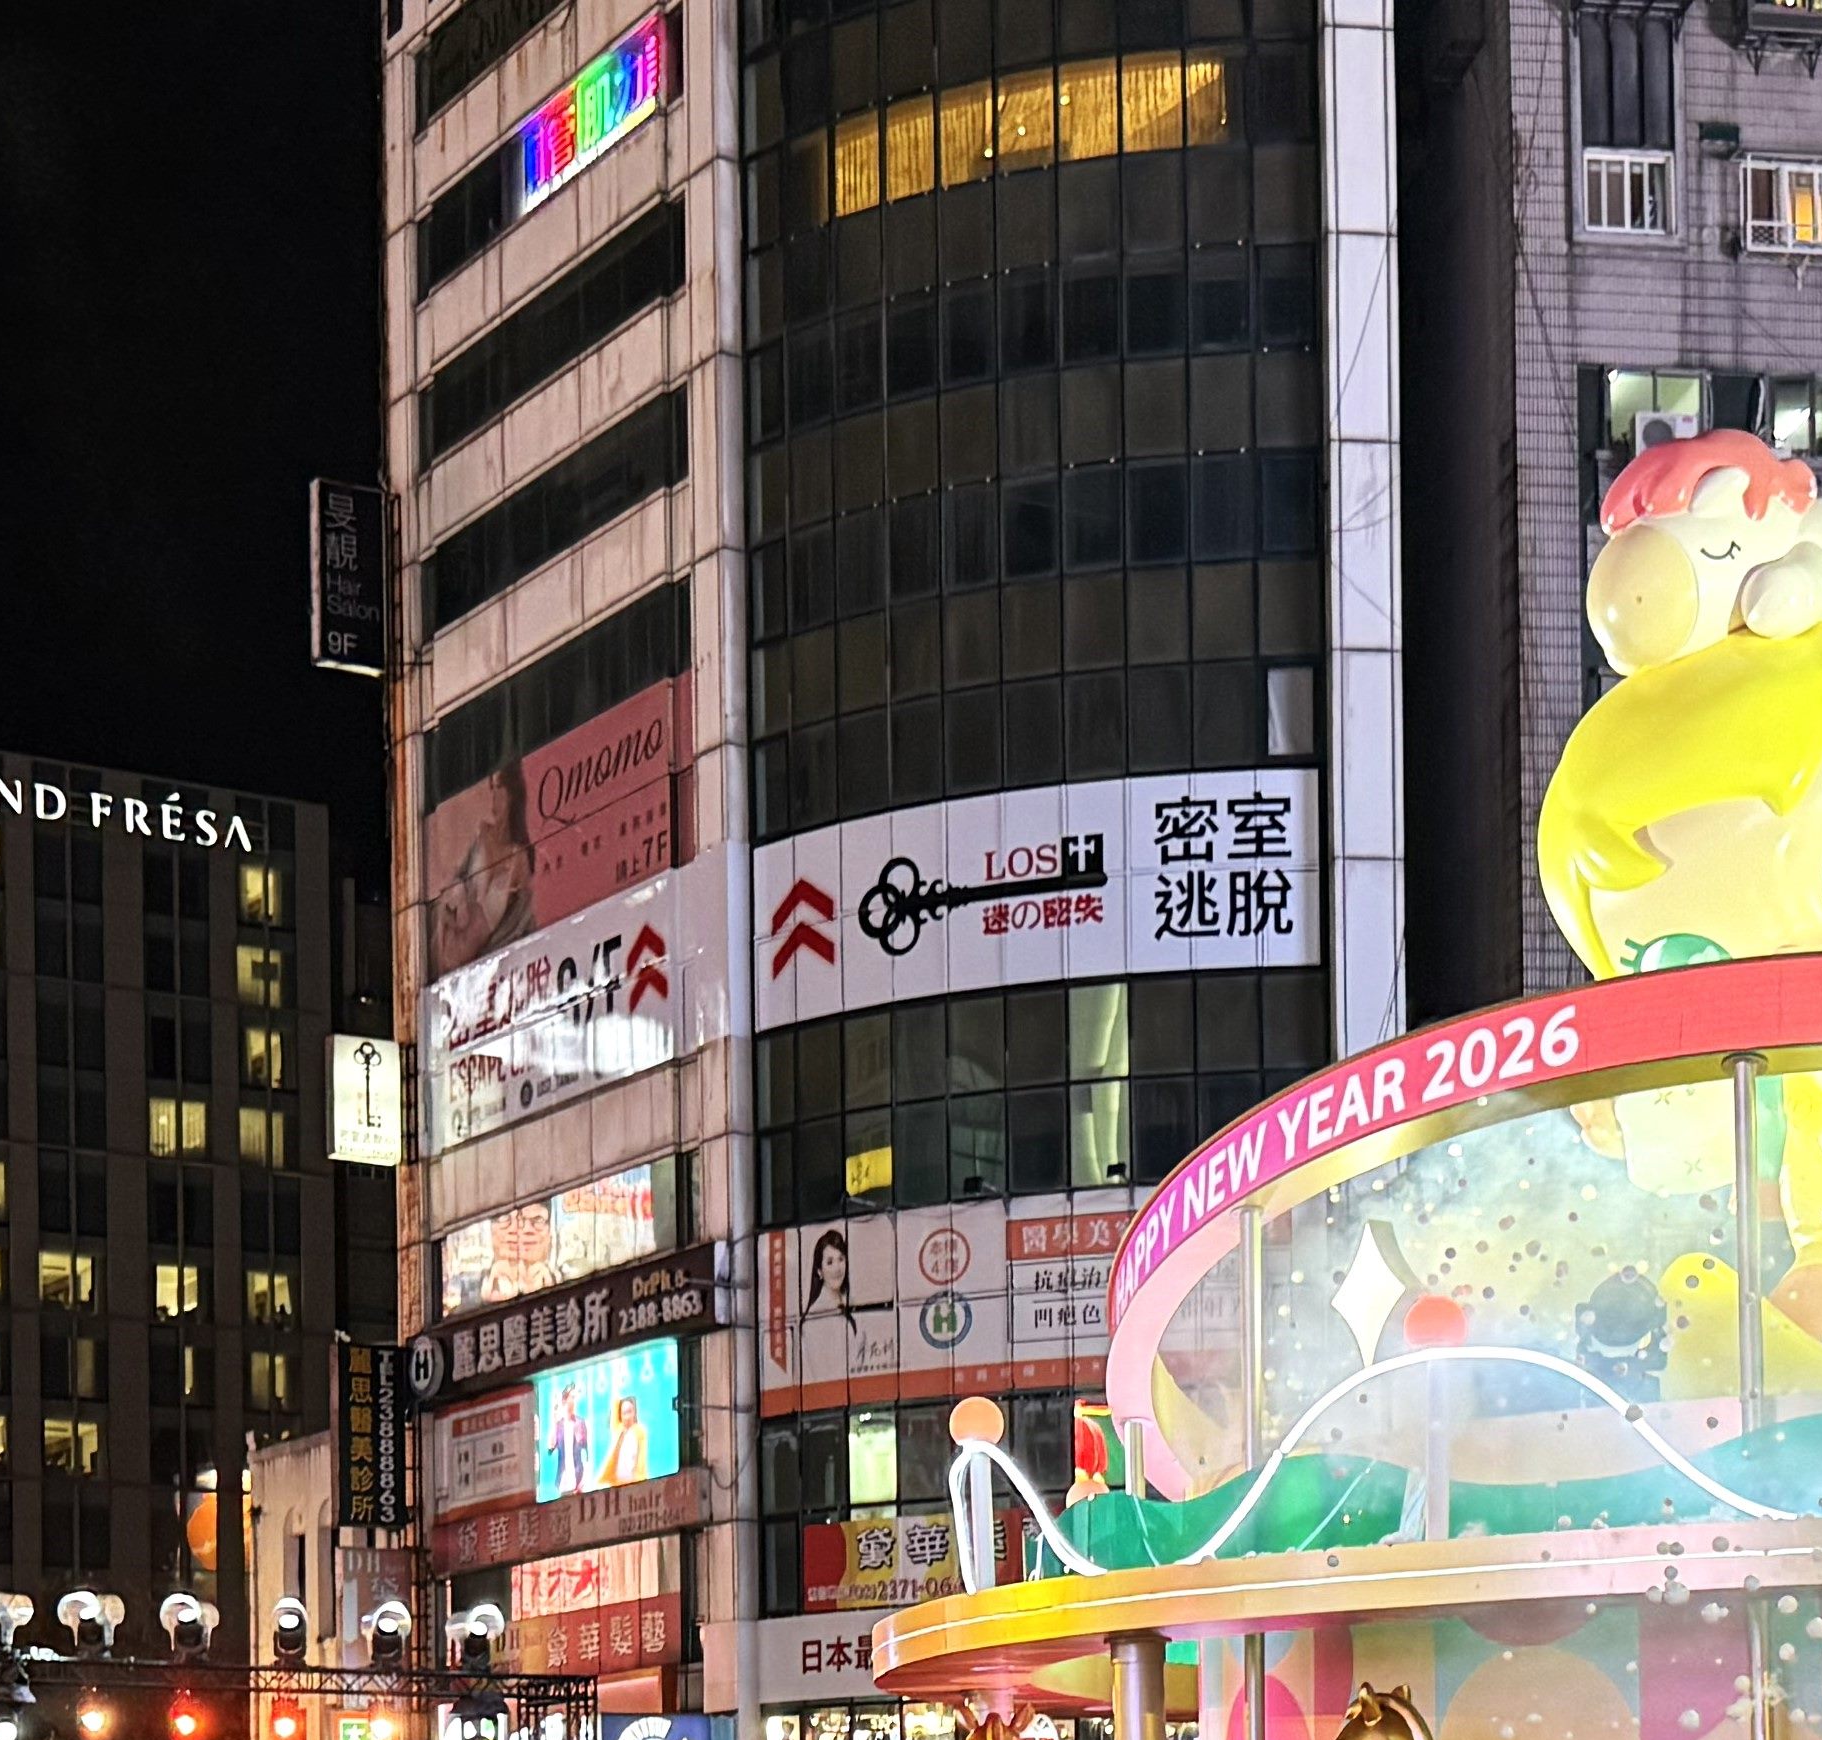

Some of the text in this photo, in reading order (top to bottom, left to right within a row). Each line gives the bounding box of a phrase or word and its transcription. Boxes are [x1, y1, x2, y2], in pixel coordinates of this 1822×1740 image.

[326, 573, 361, 596] Hair
[327, 595, 380, 622] Salon
[328, 631, 358, 656] 9F
[538, 717, 664, 826] Qmomo
[90, 790, 253, 854] FRÉSA
[1153, 791, 1292, 862] 密室
[983, 833, 1104, 883] LOST
[1153, 867, 1293, 941] 逃脫
[1113, 1004, 1579, 1326] HAPPY NEW YEAR 2026
[452, 1288, 612, 1383] 麗思醫美診所
[618, 1289, 704, 1335] 2388-8863
[348, 1347, 375, 1522] 麗思醫美診所
[578, 1486, 621, 1524] DH
[801, 1634, 873, 1675] 日本最
